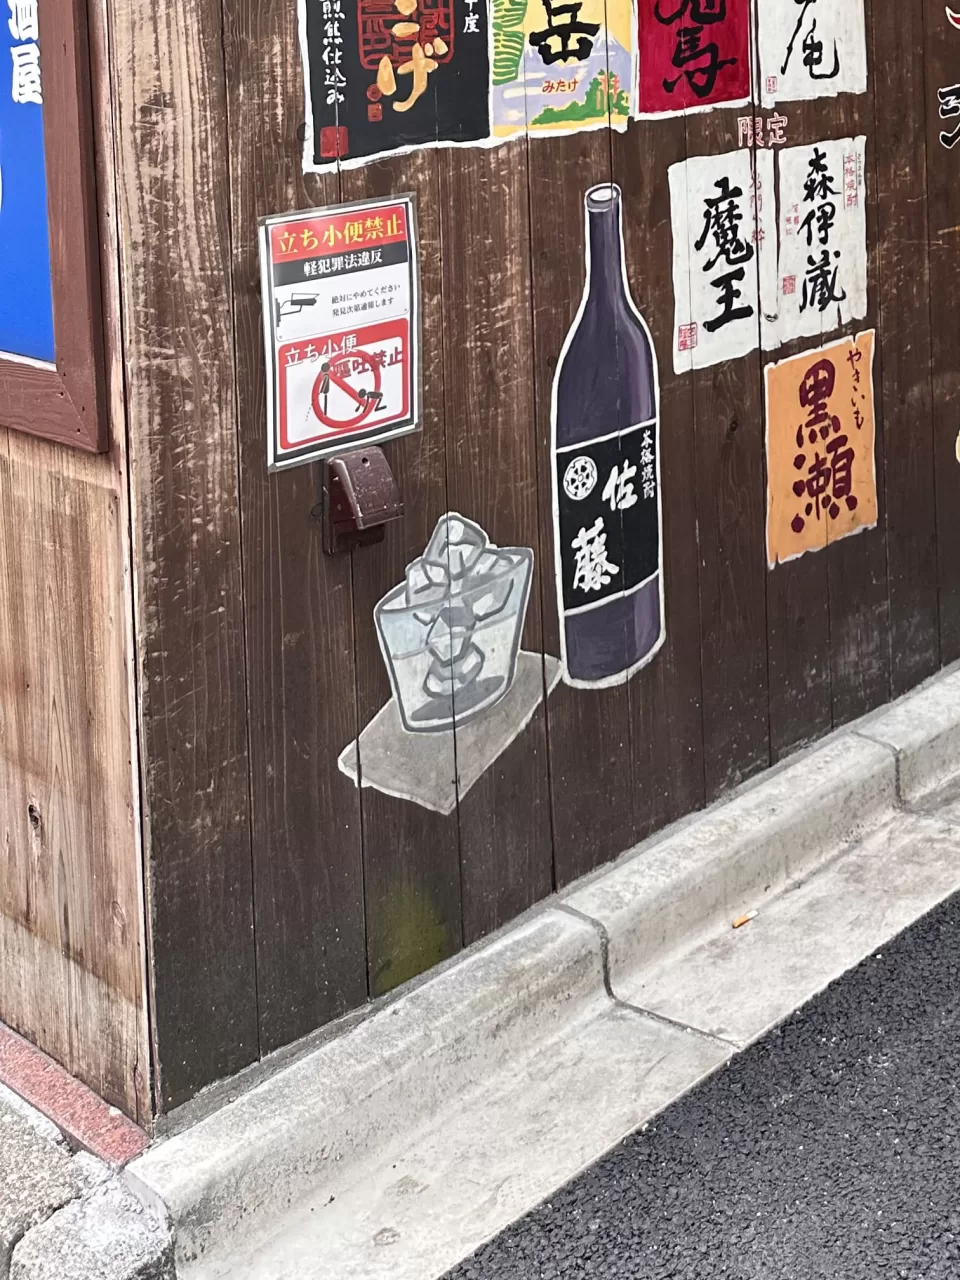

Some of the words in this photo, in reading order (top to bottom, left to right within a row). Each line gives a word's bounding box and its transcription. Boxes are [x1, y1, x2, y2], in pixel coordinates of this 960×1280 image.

[542, 79, 579, 93] みたけ
[737, 112, 788, 147] 限定
[276, 213, 404, 256] 立ち小便禁止
[303, 248, 382, 277] 軽犯罪法違反
[694, 176, 755, 332] 魔王
[331, 283, 401, 305] 絶対にやめてください
[332, 297, 394, 318] 発見次第通報します
[284, 334, 357, 367] 立ち小便
[847, 348, 866, 430] やきいも
